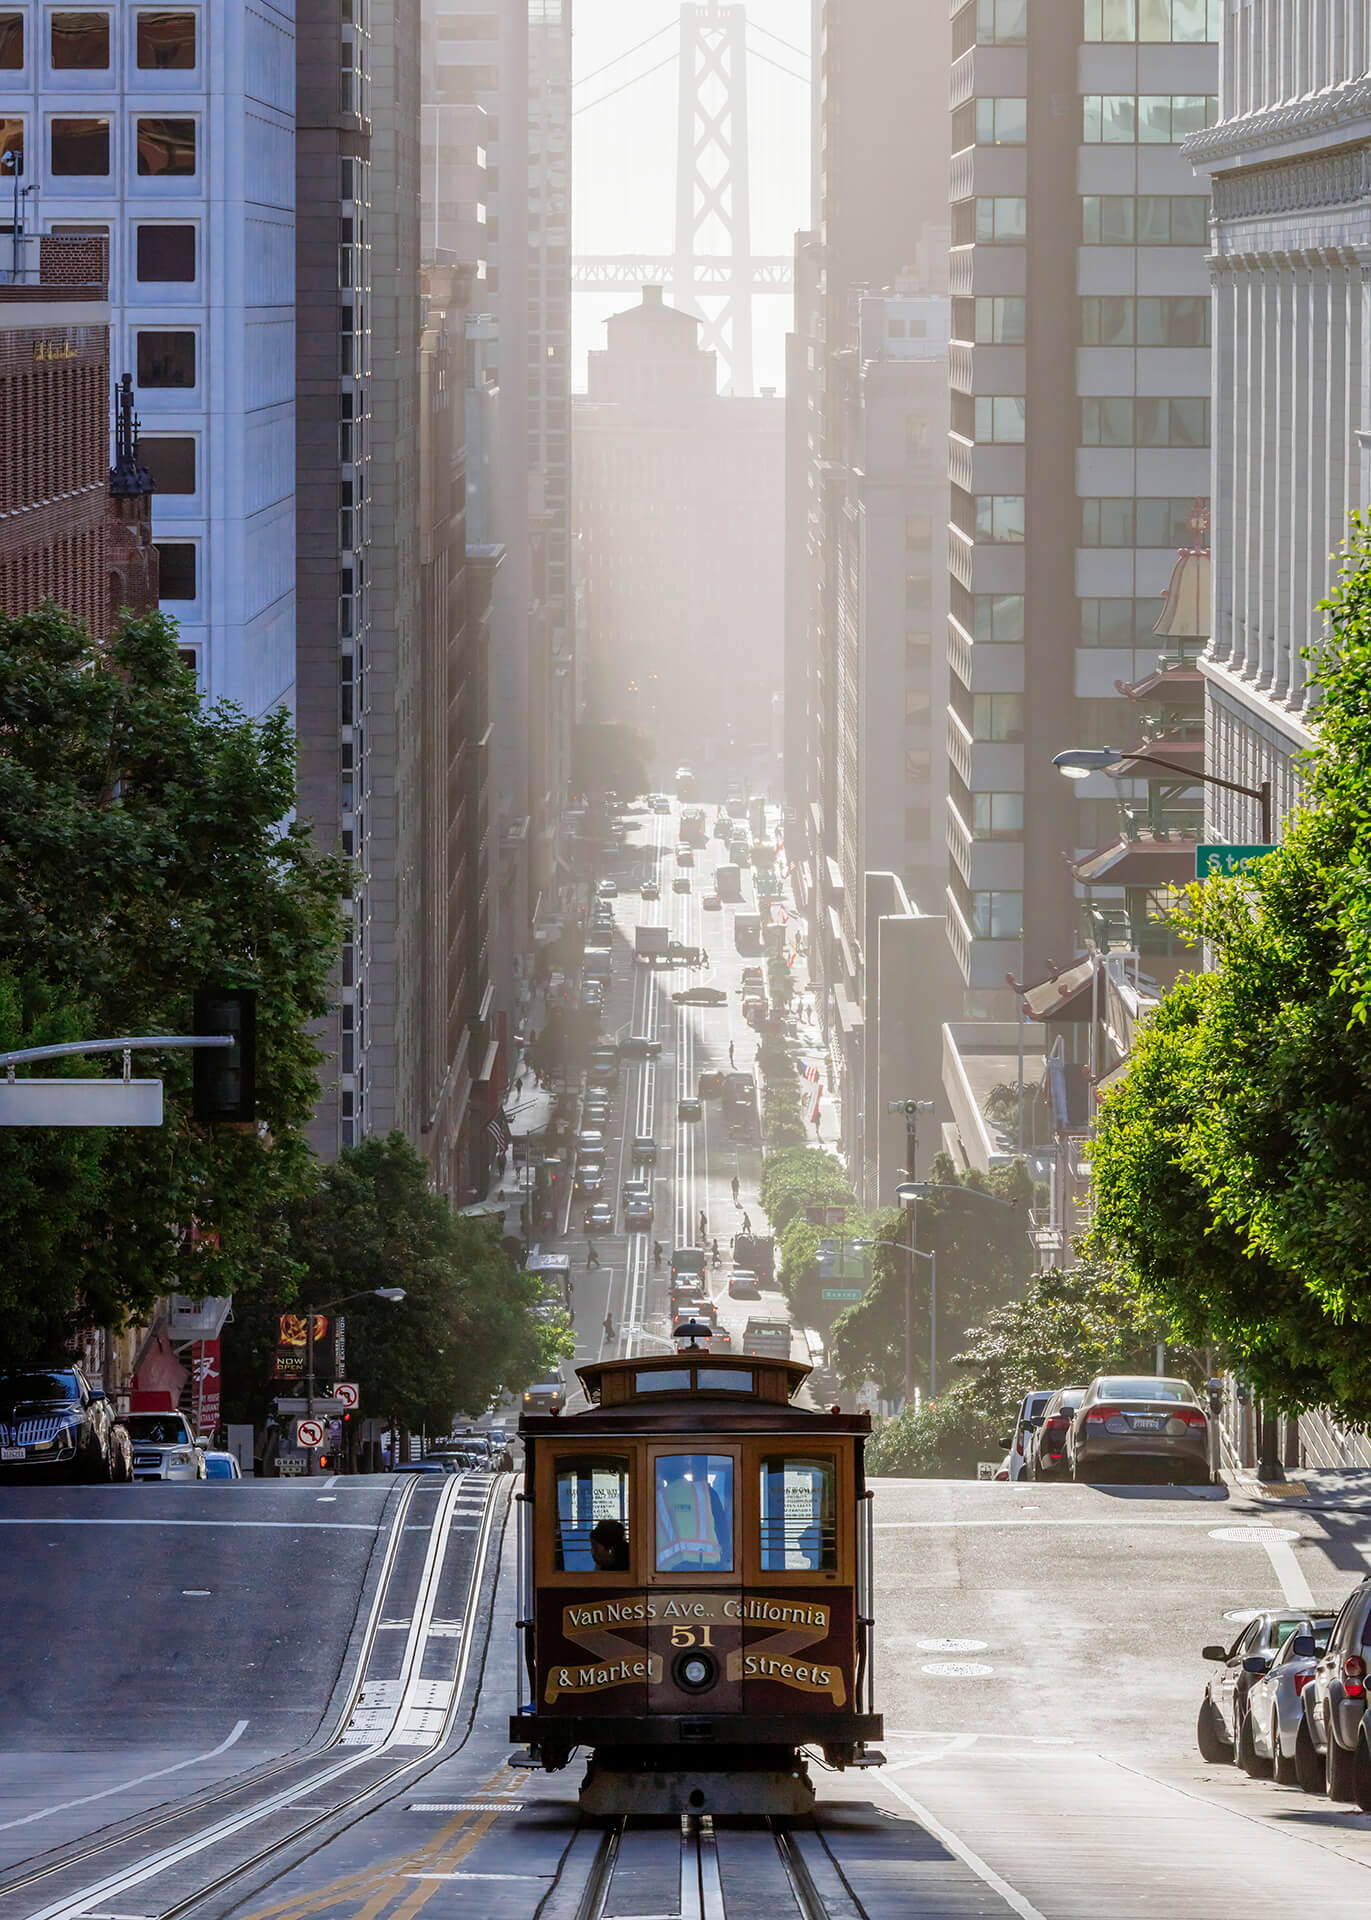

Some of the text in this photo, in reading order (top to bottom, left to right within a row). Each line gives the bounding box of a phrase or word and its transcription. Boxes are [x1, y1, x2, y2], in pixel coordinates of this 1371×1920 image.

[568, 1608, 604, 1626] Van
[606, 1603, 657, 1622] Ness
[723, 1600, 826, 1626] California
[670, 1625, 715, 1648] 51
[558, 1657, 653, 1687] & Market
[744, 1656, 832, 1685] Streets
